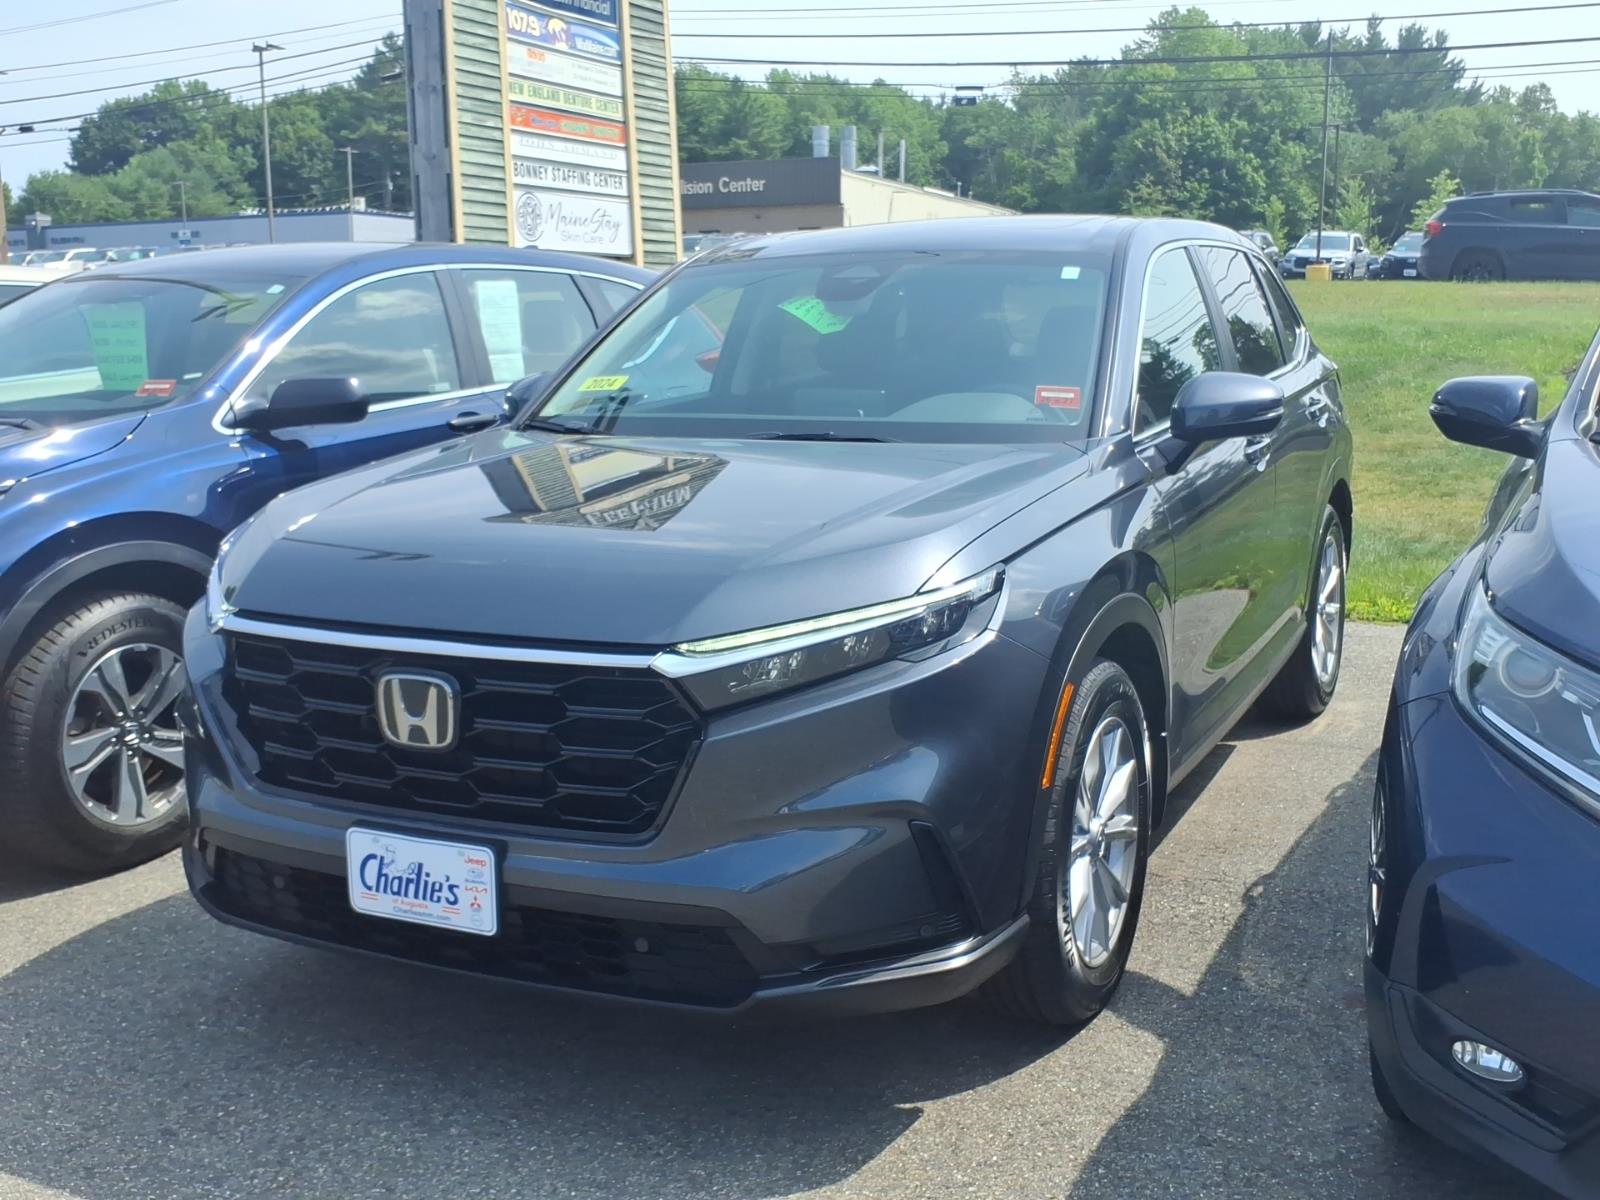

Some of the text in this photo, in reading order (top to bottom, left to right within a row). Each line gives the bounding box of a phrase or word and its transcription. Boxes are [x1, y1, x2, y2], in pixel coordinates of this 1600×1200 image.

[527, 85, 560, 105] ENGLAND
[595, 99, 619, 113] CENTER
[513, 161, 624, 190] BONNEY STAFFING CENTER
[718, 176, 766, 193] Center
[585, 377, 618, 390] 2024
[464, 855, 487, 868] Jeep
[360, 853, 460, 906] Charlie's
